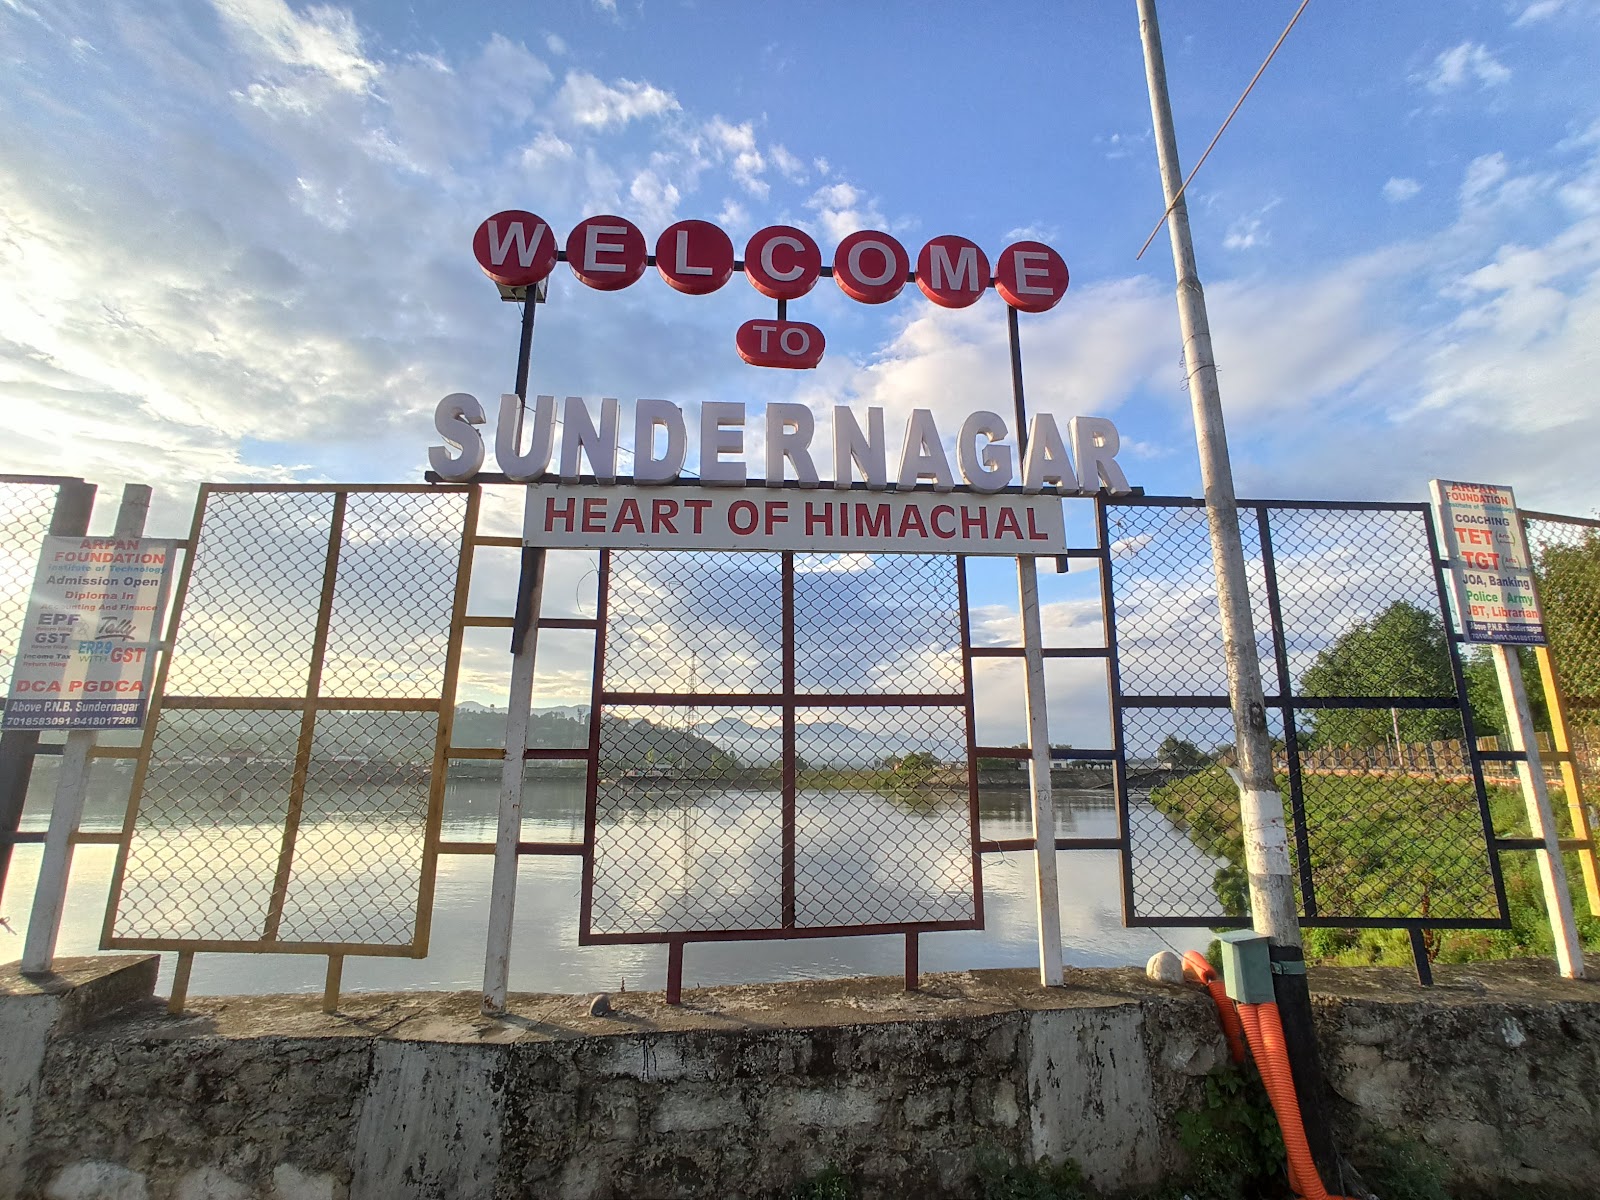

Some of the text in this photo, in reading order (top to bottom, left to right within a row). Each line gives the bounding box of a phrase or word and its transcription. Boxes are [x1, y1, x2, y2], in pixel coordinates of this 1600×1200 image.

[487, 221, 1055, 297] WELCOME
[751, 325, 811, 356] TO
[428, 392, 1133, 496] SUNDERNAGAR
[1451, 481, 1499, 495] ARPAN
[1445, 491, 1509, 506] FOUNDATION
[544, 496, 1049, 541] HEART OF HIMACHAL
[1455, 513, 1510, 527] COACHING
[1453, 527, 1493, 546] TET
[80, 538, 139, 551] ARPAN
[54, 551, 166, 564] FOUNDATION
[1461, 551, 1500, 571] TGT
[95, 564, 107, 573] of
[109, 565, 168, 576] Technology
[46, 575, 159, 588] Admission Open
[1462, 574, 1530, 591] JOA, Banking
[64, 590, 134, 601] Diploma In
[1466, 590, 1533, 607] Police Army
[40, 603, 159, 613] Accunting And Finance
[1491, 606, 1539, 619] Librarian
[38, 613, 137, 641] EPF Tally
[35, 632, 71, 644] GST
[56, 652, 72, 660] Tax
[111, 647, 147, 664] GST
[16, 679, 145, 693] DCA PGDCA
[11, 701, 141, 715] Above P.N.B. Sundernagar
